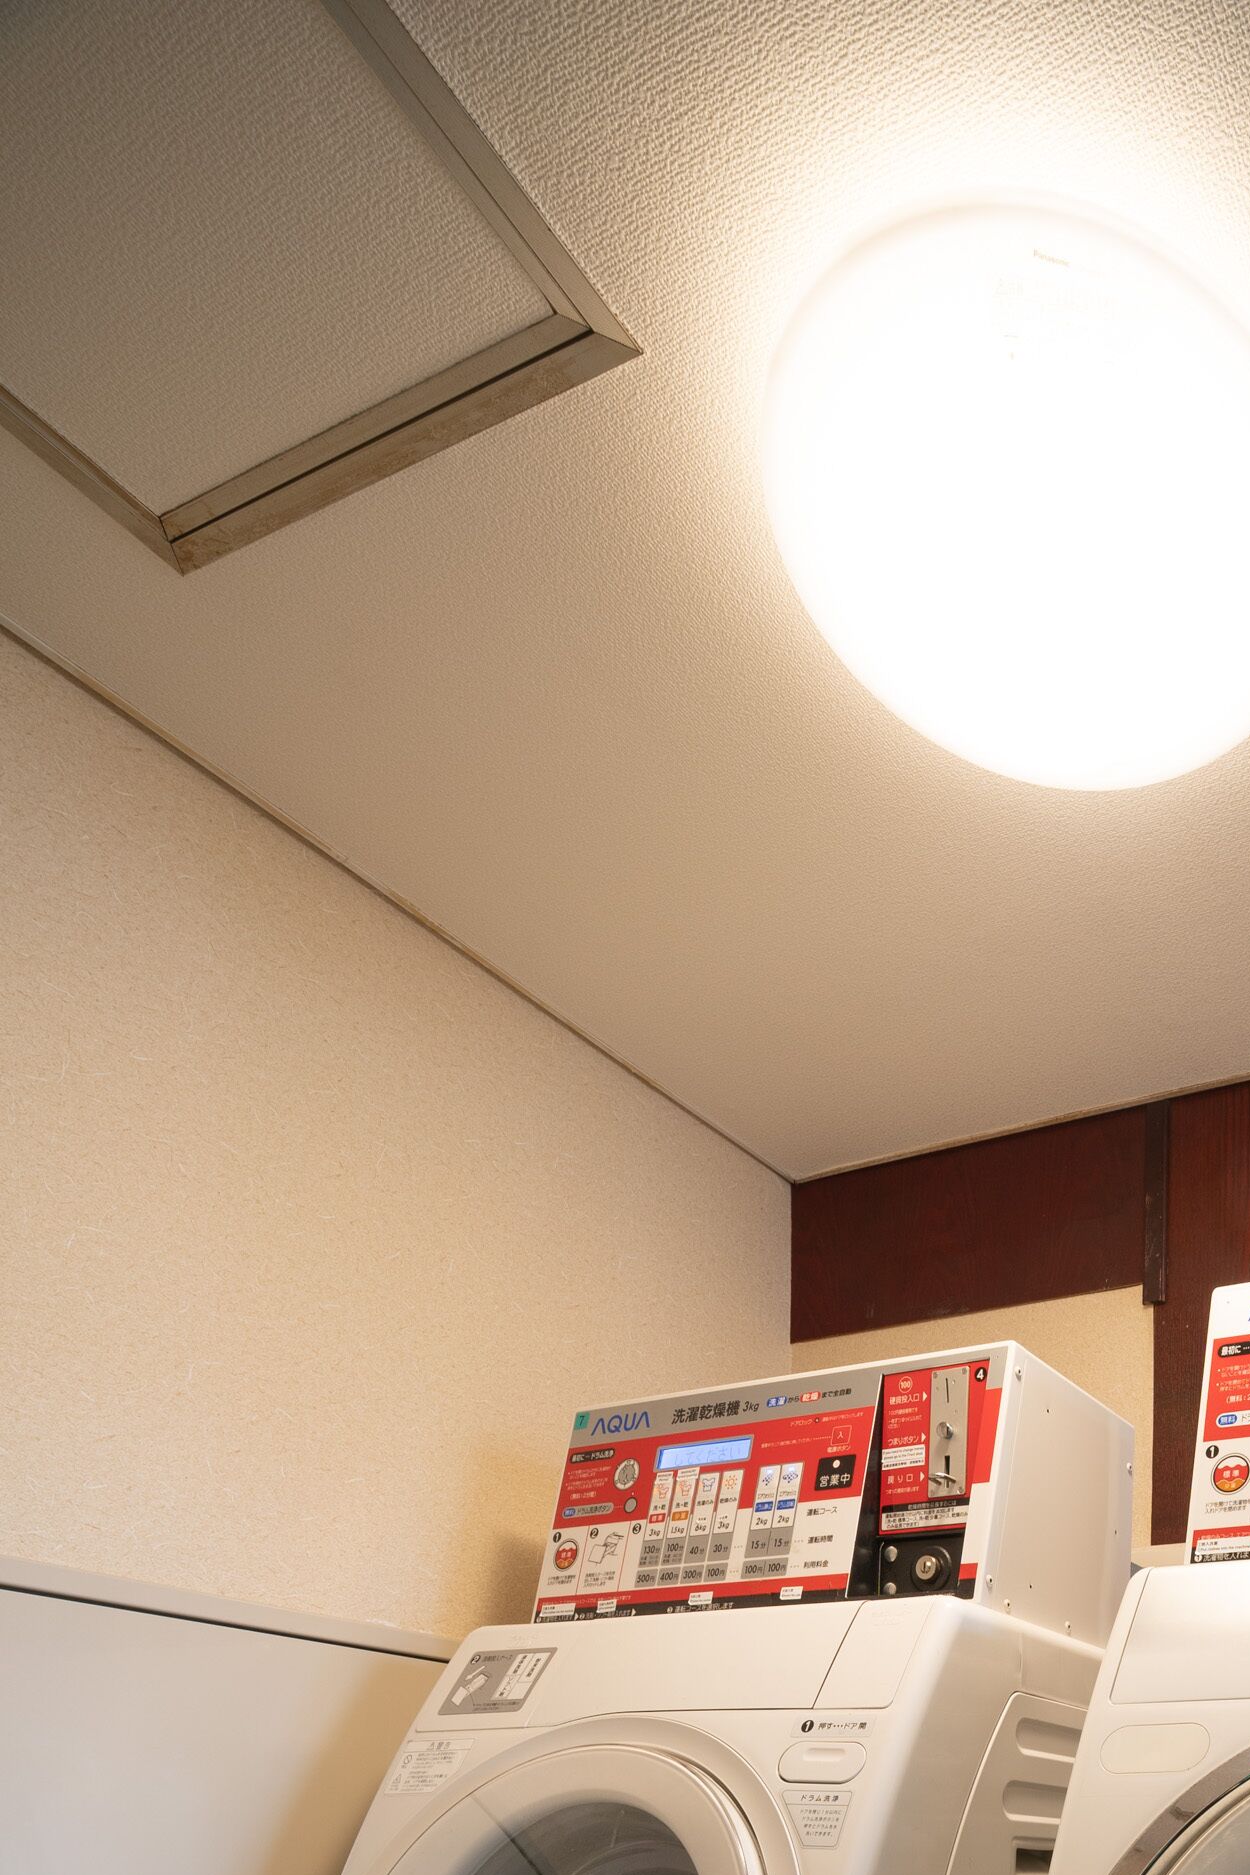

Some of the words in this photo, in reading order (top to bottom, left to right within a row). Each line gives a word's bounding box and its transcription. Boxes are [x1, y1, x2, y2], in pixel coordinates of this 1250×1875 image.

[889, 1394, 920, 1405] 硬貨投入口
[671, 1400, 740, 1425] 洗濯乾燥機
[743, 1402, 760, 1412] 3kg
[591, 1411, 650, 1436] AQUA
[819, 1472, 851, 1488] 営業中
[806, 1506, 838, 1517] 運転コース
[756, 1517, 768, 1526] 2kg
[777, 1515, 790, 1524] 2kg
[694, 1524, 707, 1533] 6kg
[717, 1520, 730, 1530] 3kg
[649, 1529, 660, 1537] 3kg
[807, 1535, 834, 1544] 運転時間
[804, 1559, 829, 1569] 利用料金
